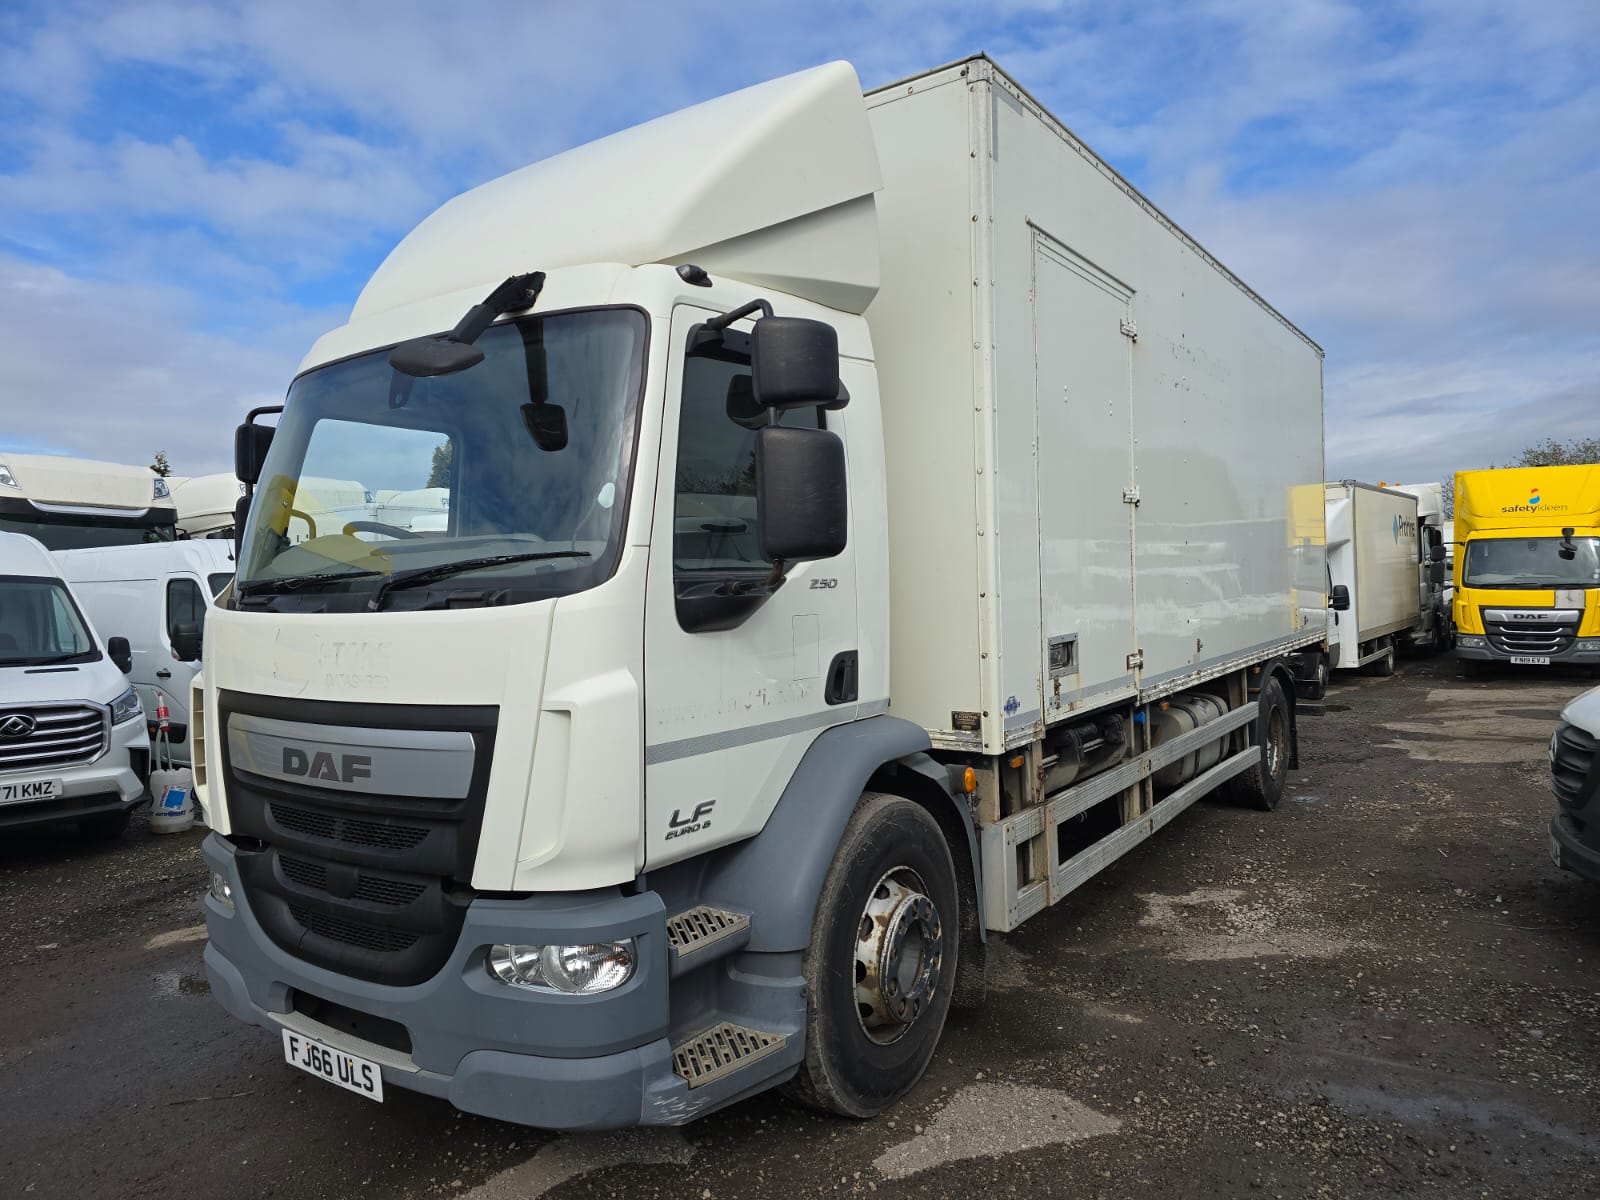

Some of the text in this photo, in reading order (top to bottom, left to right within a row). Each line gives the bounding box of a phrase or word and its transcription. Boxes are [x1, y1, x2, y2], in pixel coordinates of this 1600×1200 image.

[1502, 504, 1568, 513] safetykleen
[809, 578, 838, 590] 250
[282, 746, 372, 784] DAF
[0, 781, 53, 800] 71 KMZ
[669, 799, 716, 828] LF
[664, 823, 701, 840] EURO
[289, 1035, 374, 1093] FJ66 ULS
